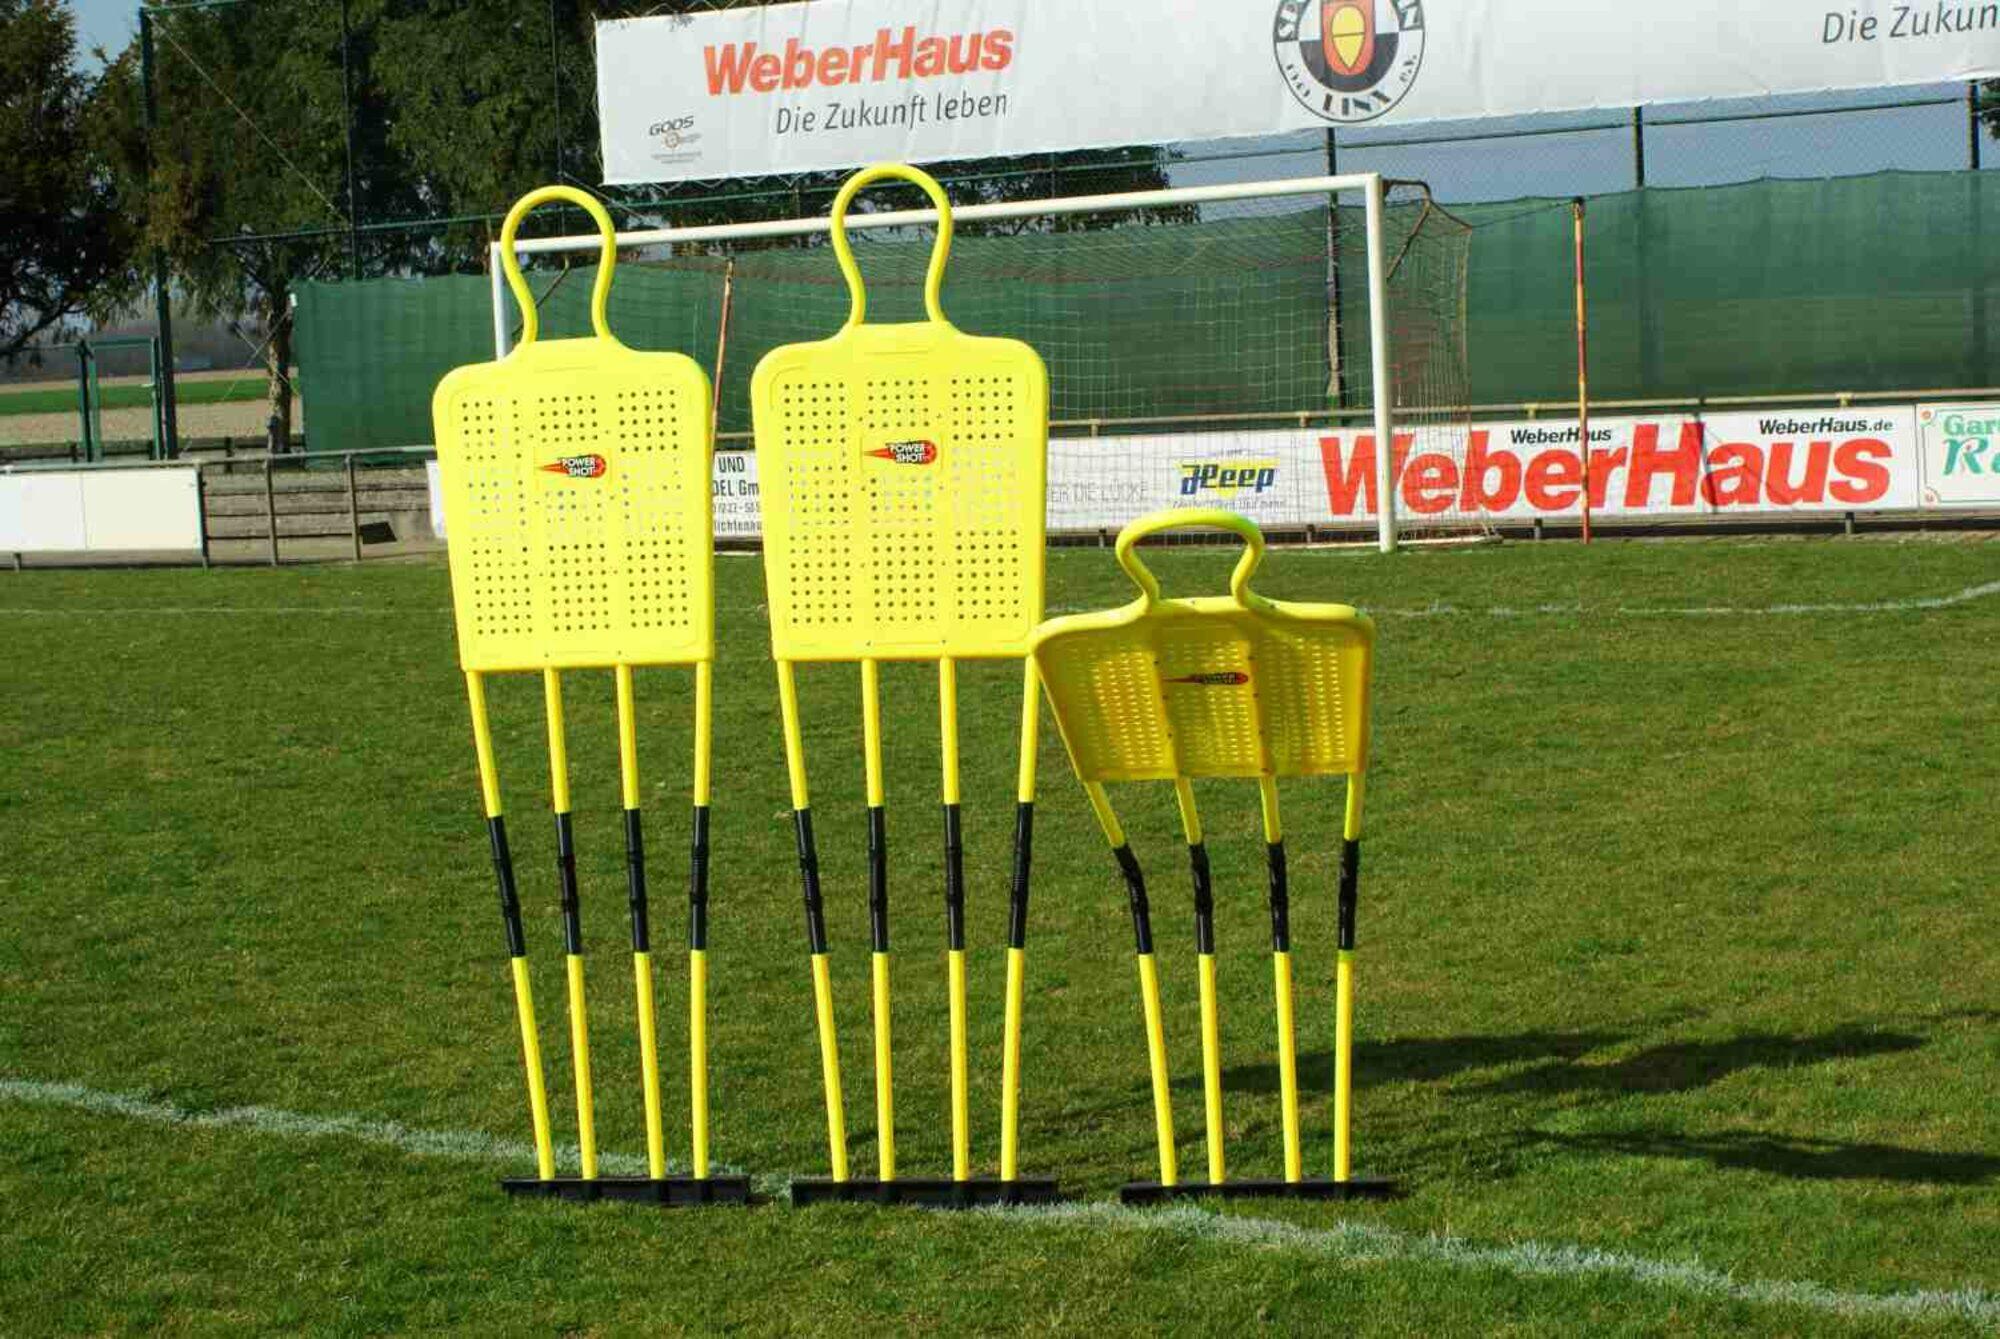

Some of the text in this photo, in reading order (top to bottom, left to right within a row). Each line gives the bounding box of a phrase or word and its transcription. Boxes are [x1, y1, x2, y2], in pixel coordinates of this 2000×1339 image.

[1822, 10, 1878, 43] Die
[703, 26, 1014, 96] WeberHaus
[776, 90, 1008, 134] Die Zukunft leben
[1759, 417, 1893, 435] WeberHaus.de
[889, 442, 925, 454] POWER
[561, 456, 595, 468] POWER
[718, 456, 745, 473] UND
[895, 452, 925, 463] SHOT
[568, 465, 595, 477] SHOT
[1318, 421, 1892, 516] WeberHaus
